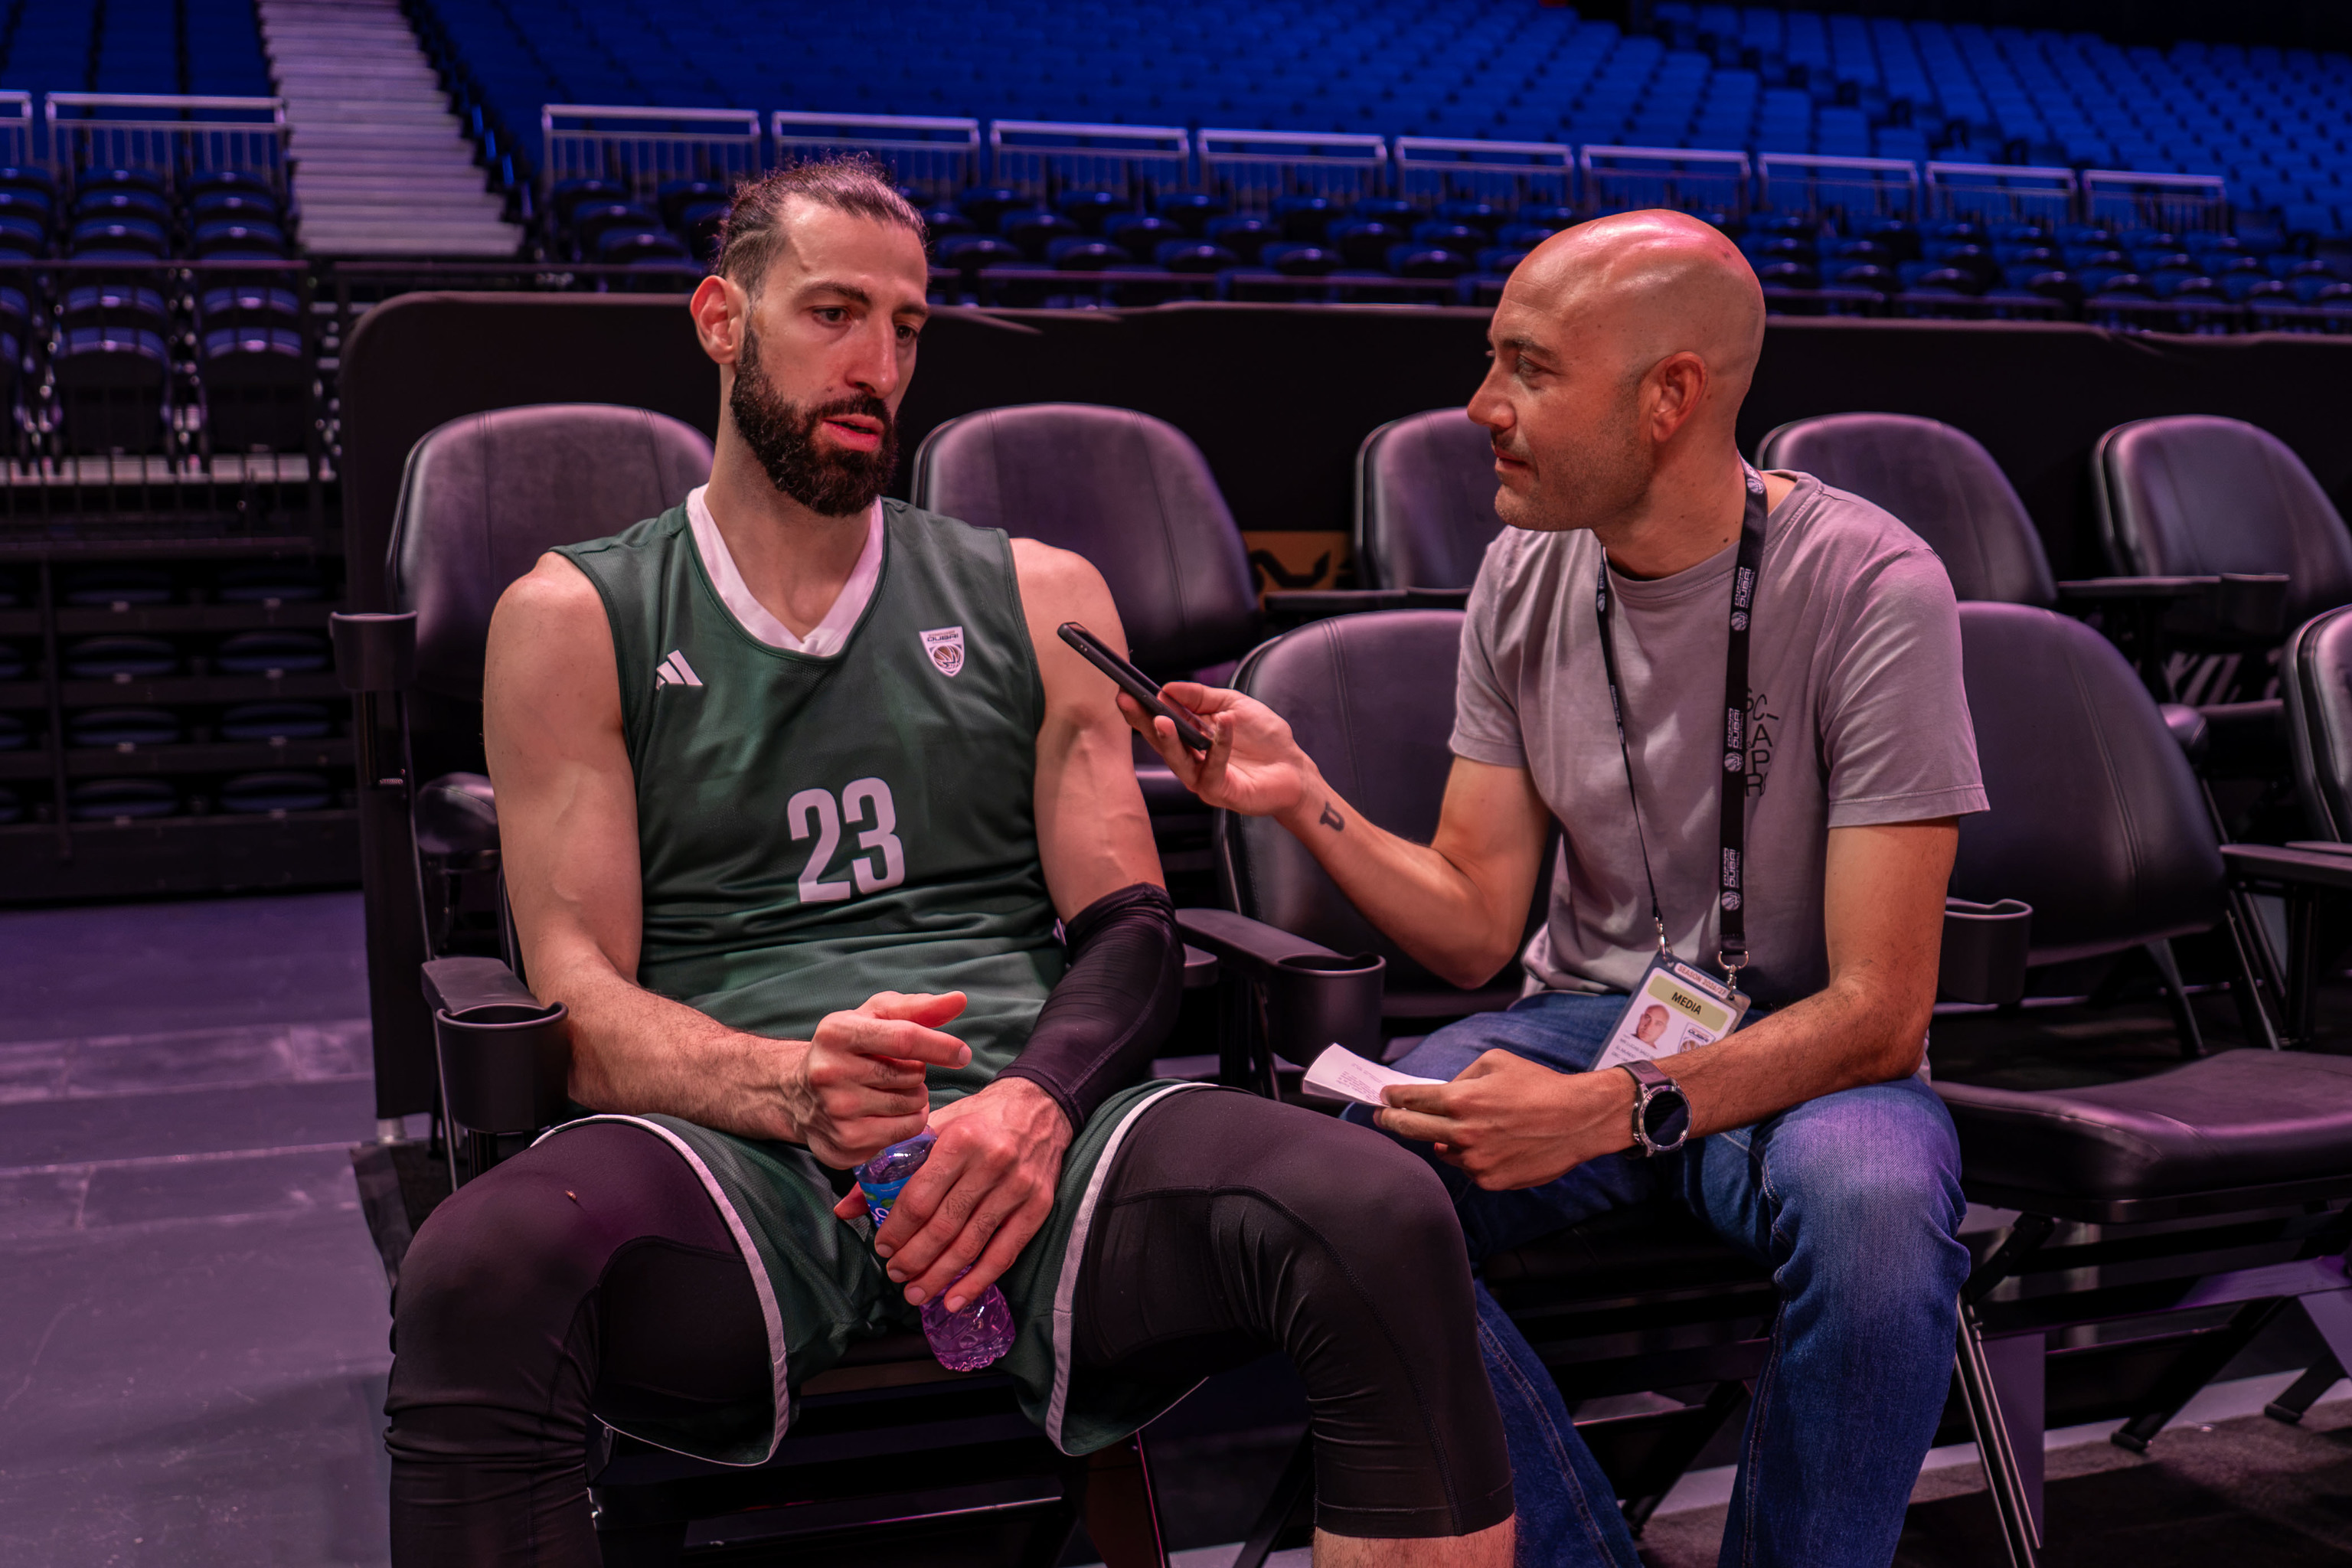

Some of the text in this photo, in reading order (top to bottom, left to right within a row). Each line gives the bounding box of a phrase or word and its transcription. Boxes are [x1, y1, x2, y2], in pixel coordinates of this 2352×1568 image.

[1740, 568, 1752, 607] DUBAI
[927, 633, 959, 642] DUBAI
[787, 776, 905, 903] 23
[1677, 965, 1701, 982] SEASON
[1671, 991, 1702, 1015] MEDIA
